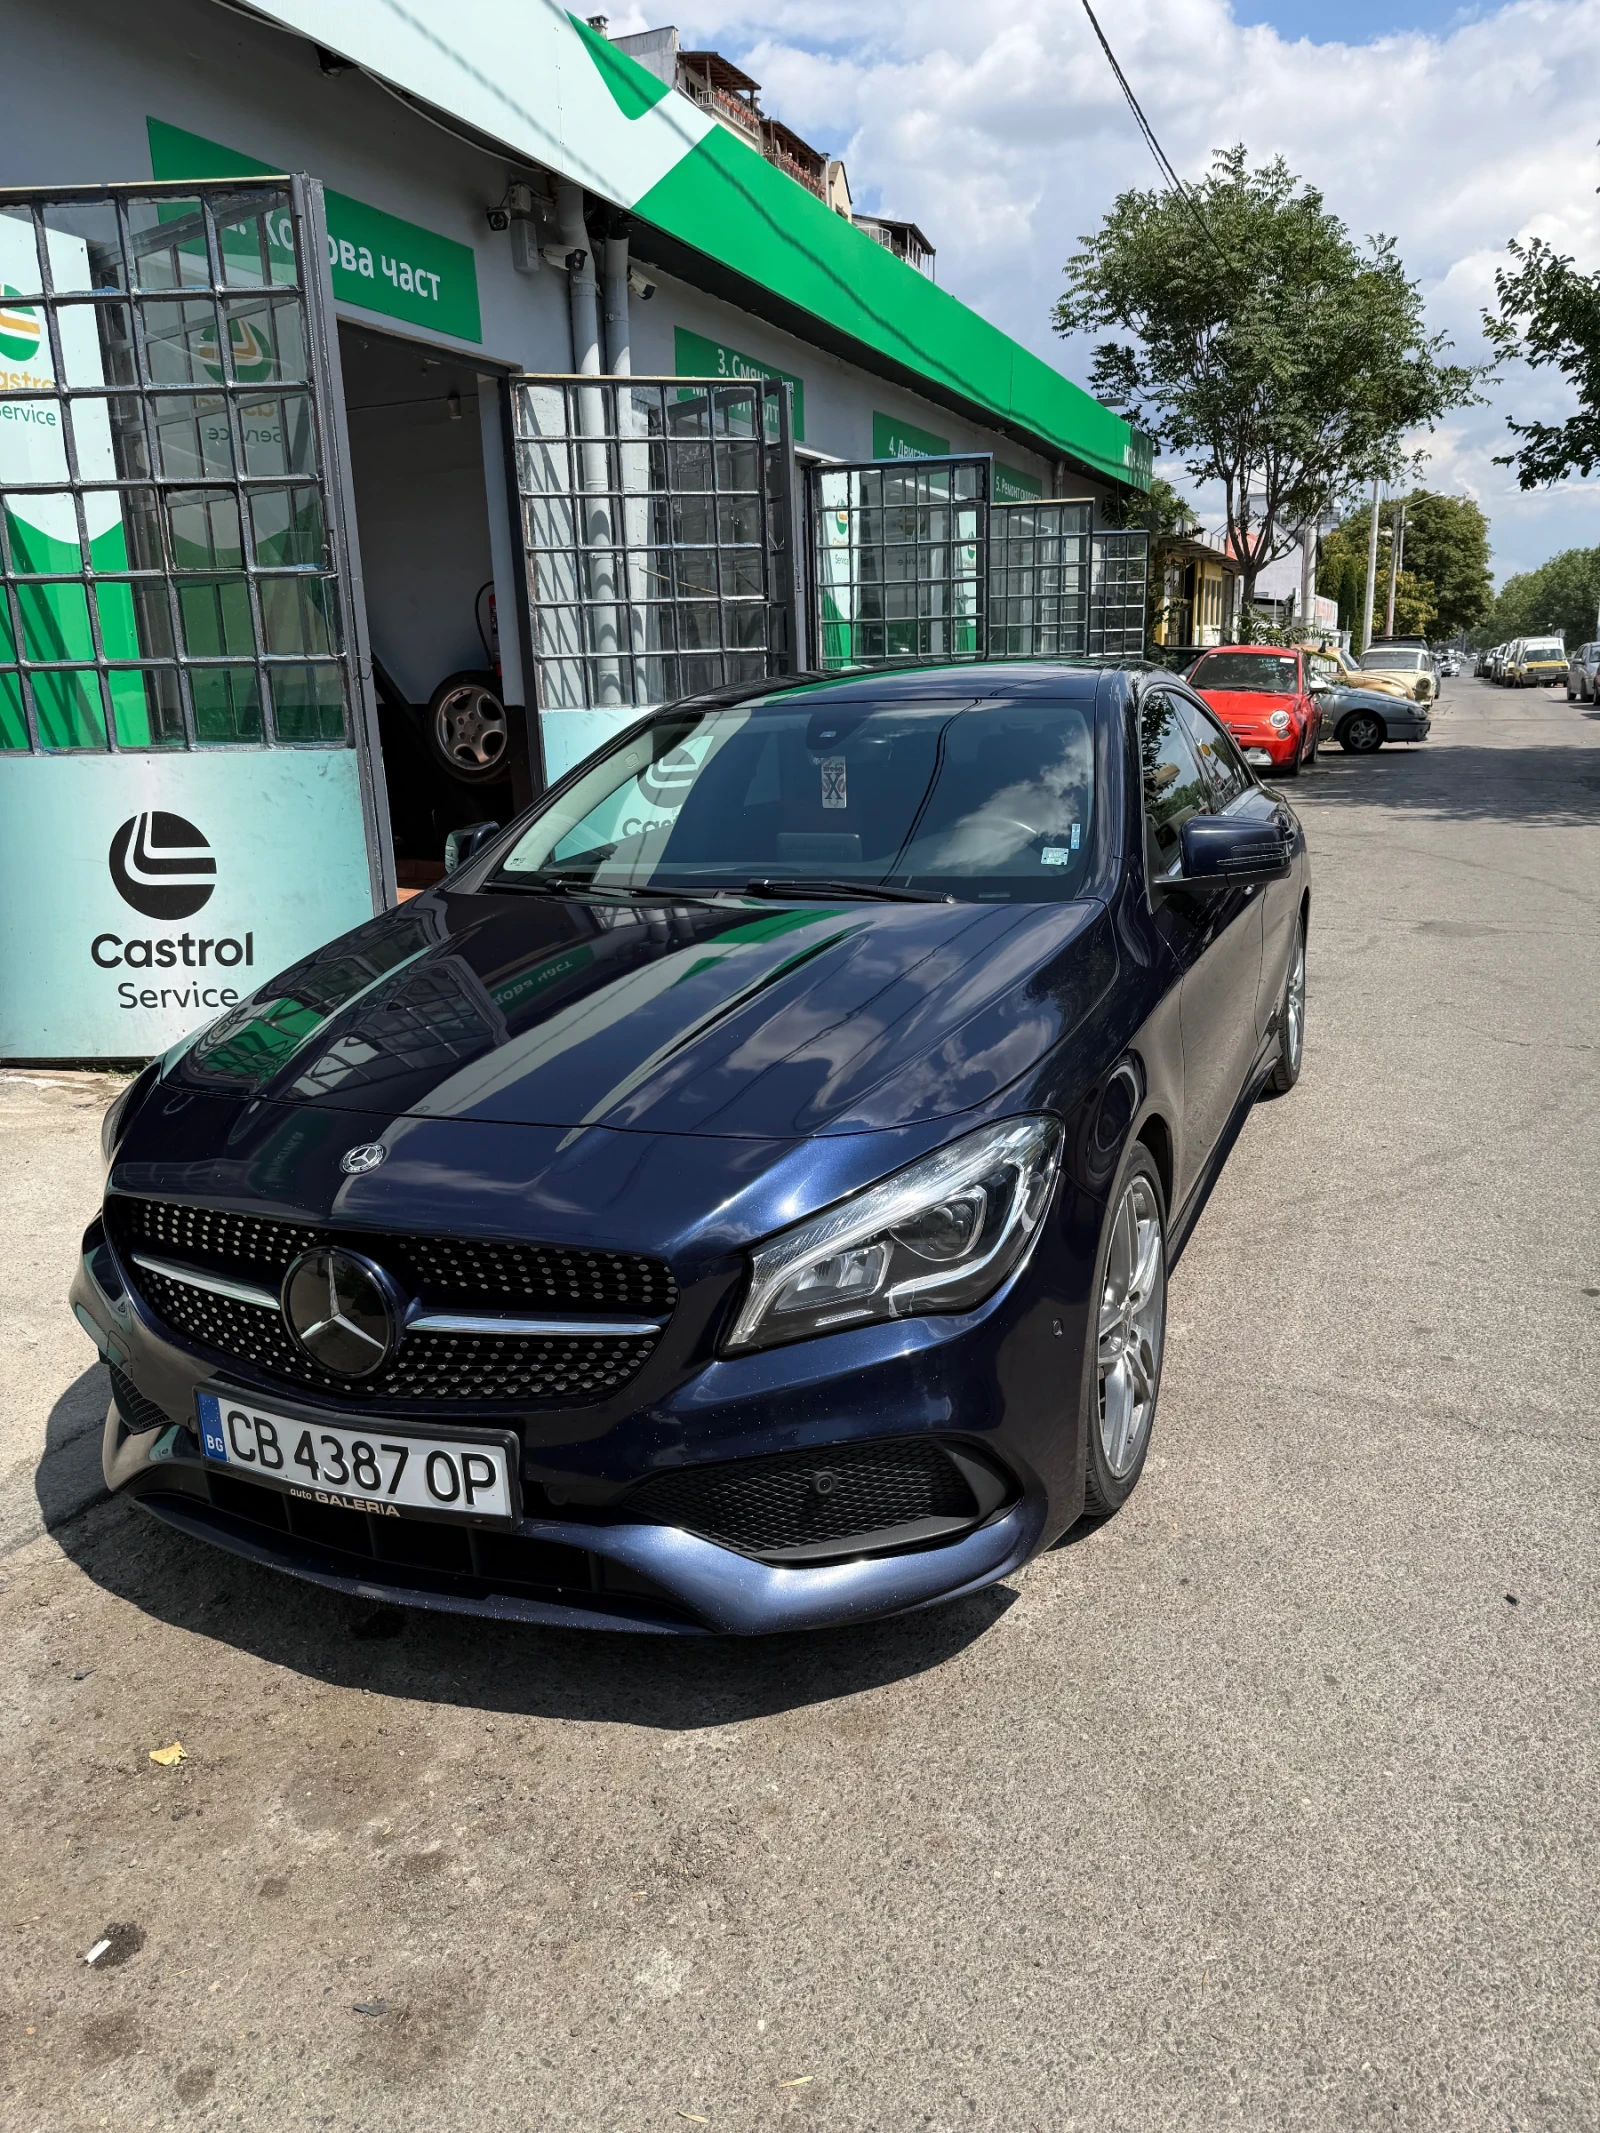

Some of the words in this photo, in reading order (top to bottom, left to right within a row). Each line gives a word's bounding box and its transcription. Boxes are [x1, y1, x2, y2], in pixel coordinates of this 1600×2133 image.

[381, 255, 441, 301] част
[717, 349, 729, 376] 3.
[732, 355, 770, 380] Смян
[0, 404, 56, 426] ervice
[889, 436, 896, 456] 4.
[996, 476, 1001, 492] 5.
[824, 773, 843, 799] X
[91, 931, 254, 969] Castrol
[117, 980, 239, 1009] Service
[206, 1434, 224, 1452] BG
[227, 1410, 284, 1470] CB
[294, 1430, 409, 1495] 4387
[426, 1450, 497, 1505] OP
[290, 1488, 312, 1500] auto
[314, 1491, 400, 1517] GALERIA
